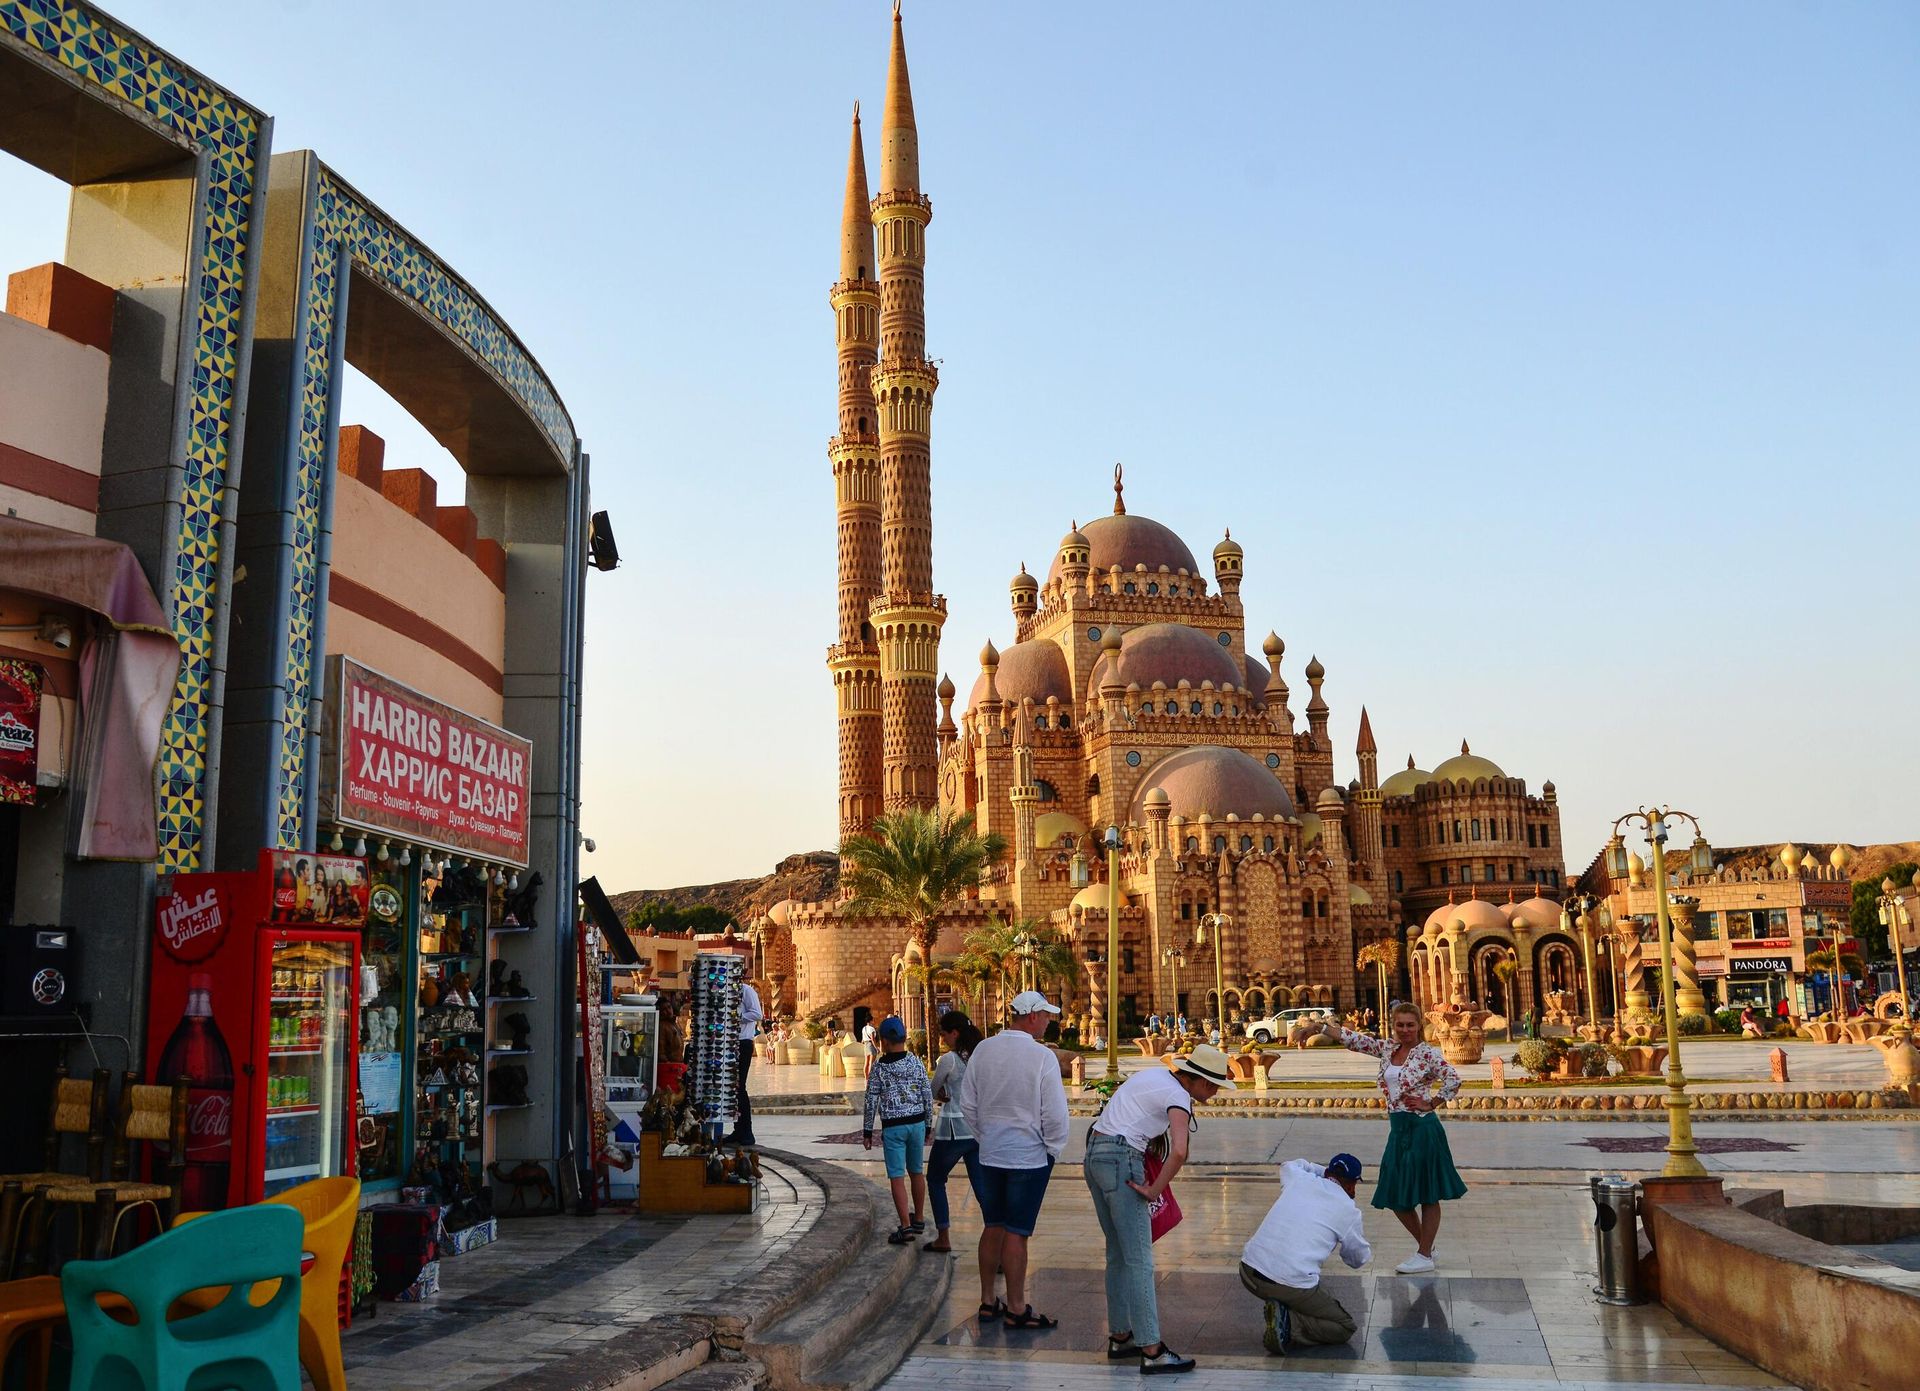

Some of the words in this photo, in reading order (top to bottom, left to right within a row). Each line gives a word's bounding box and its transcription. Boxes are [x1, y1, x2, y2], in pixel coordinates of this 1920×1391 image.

[352, 685, 442, 758] HARRIS
[448, 725, 523, 787] BAZAAR
[350, 781, 378, 803] Perfume
[383, 791, 410, 812] Souvenir
[415, 801, 439, 820] Papyrus
[358, 739, 452, 804] ХАРРИС
[458, 773, 518, 822] БАЗАР
[449, 811, 465, 826] Духи
[470, 817, 496, 835] Сувенир
[499, 825, 523, 843] Папирус
[160, 888, 218, 938] عيش
[1734, 958, 1787, 970] PANDORA
